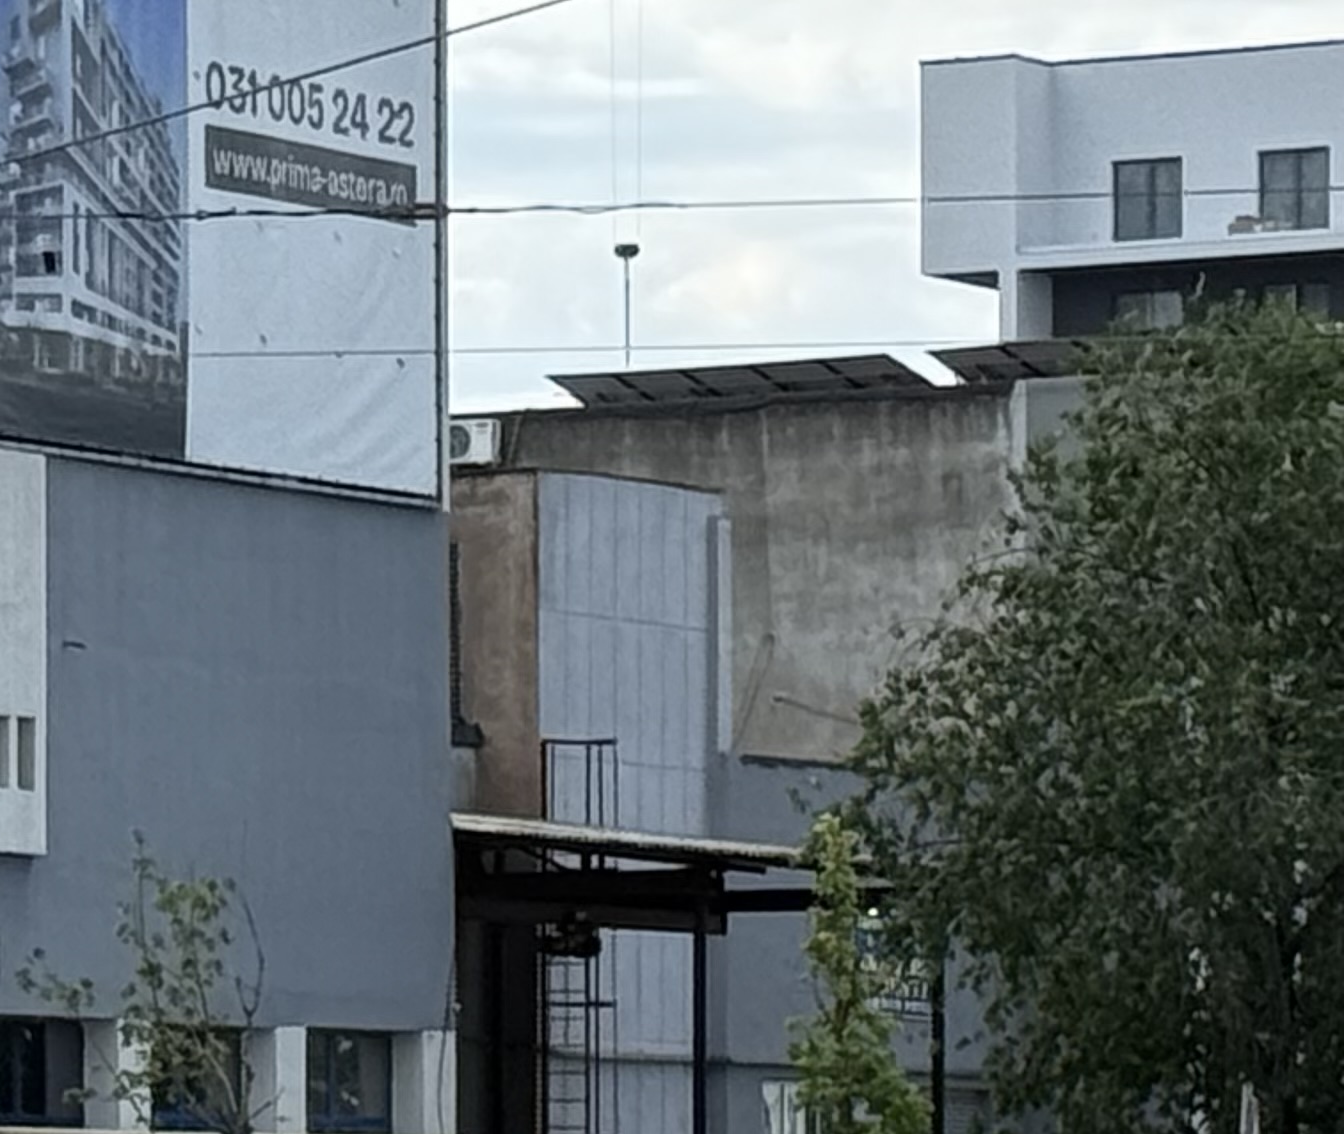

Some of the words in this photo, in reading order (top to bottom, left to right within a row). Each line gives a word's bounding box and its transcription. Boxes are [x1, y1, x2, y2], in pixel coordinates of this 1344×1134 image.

[206, 61, 259, 118] 031
[267, 74, 324, 130] 005
[331, 88, 370, 140] 24
[377, 97, 415, 148] 22
